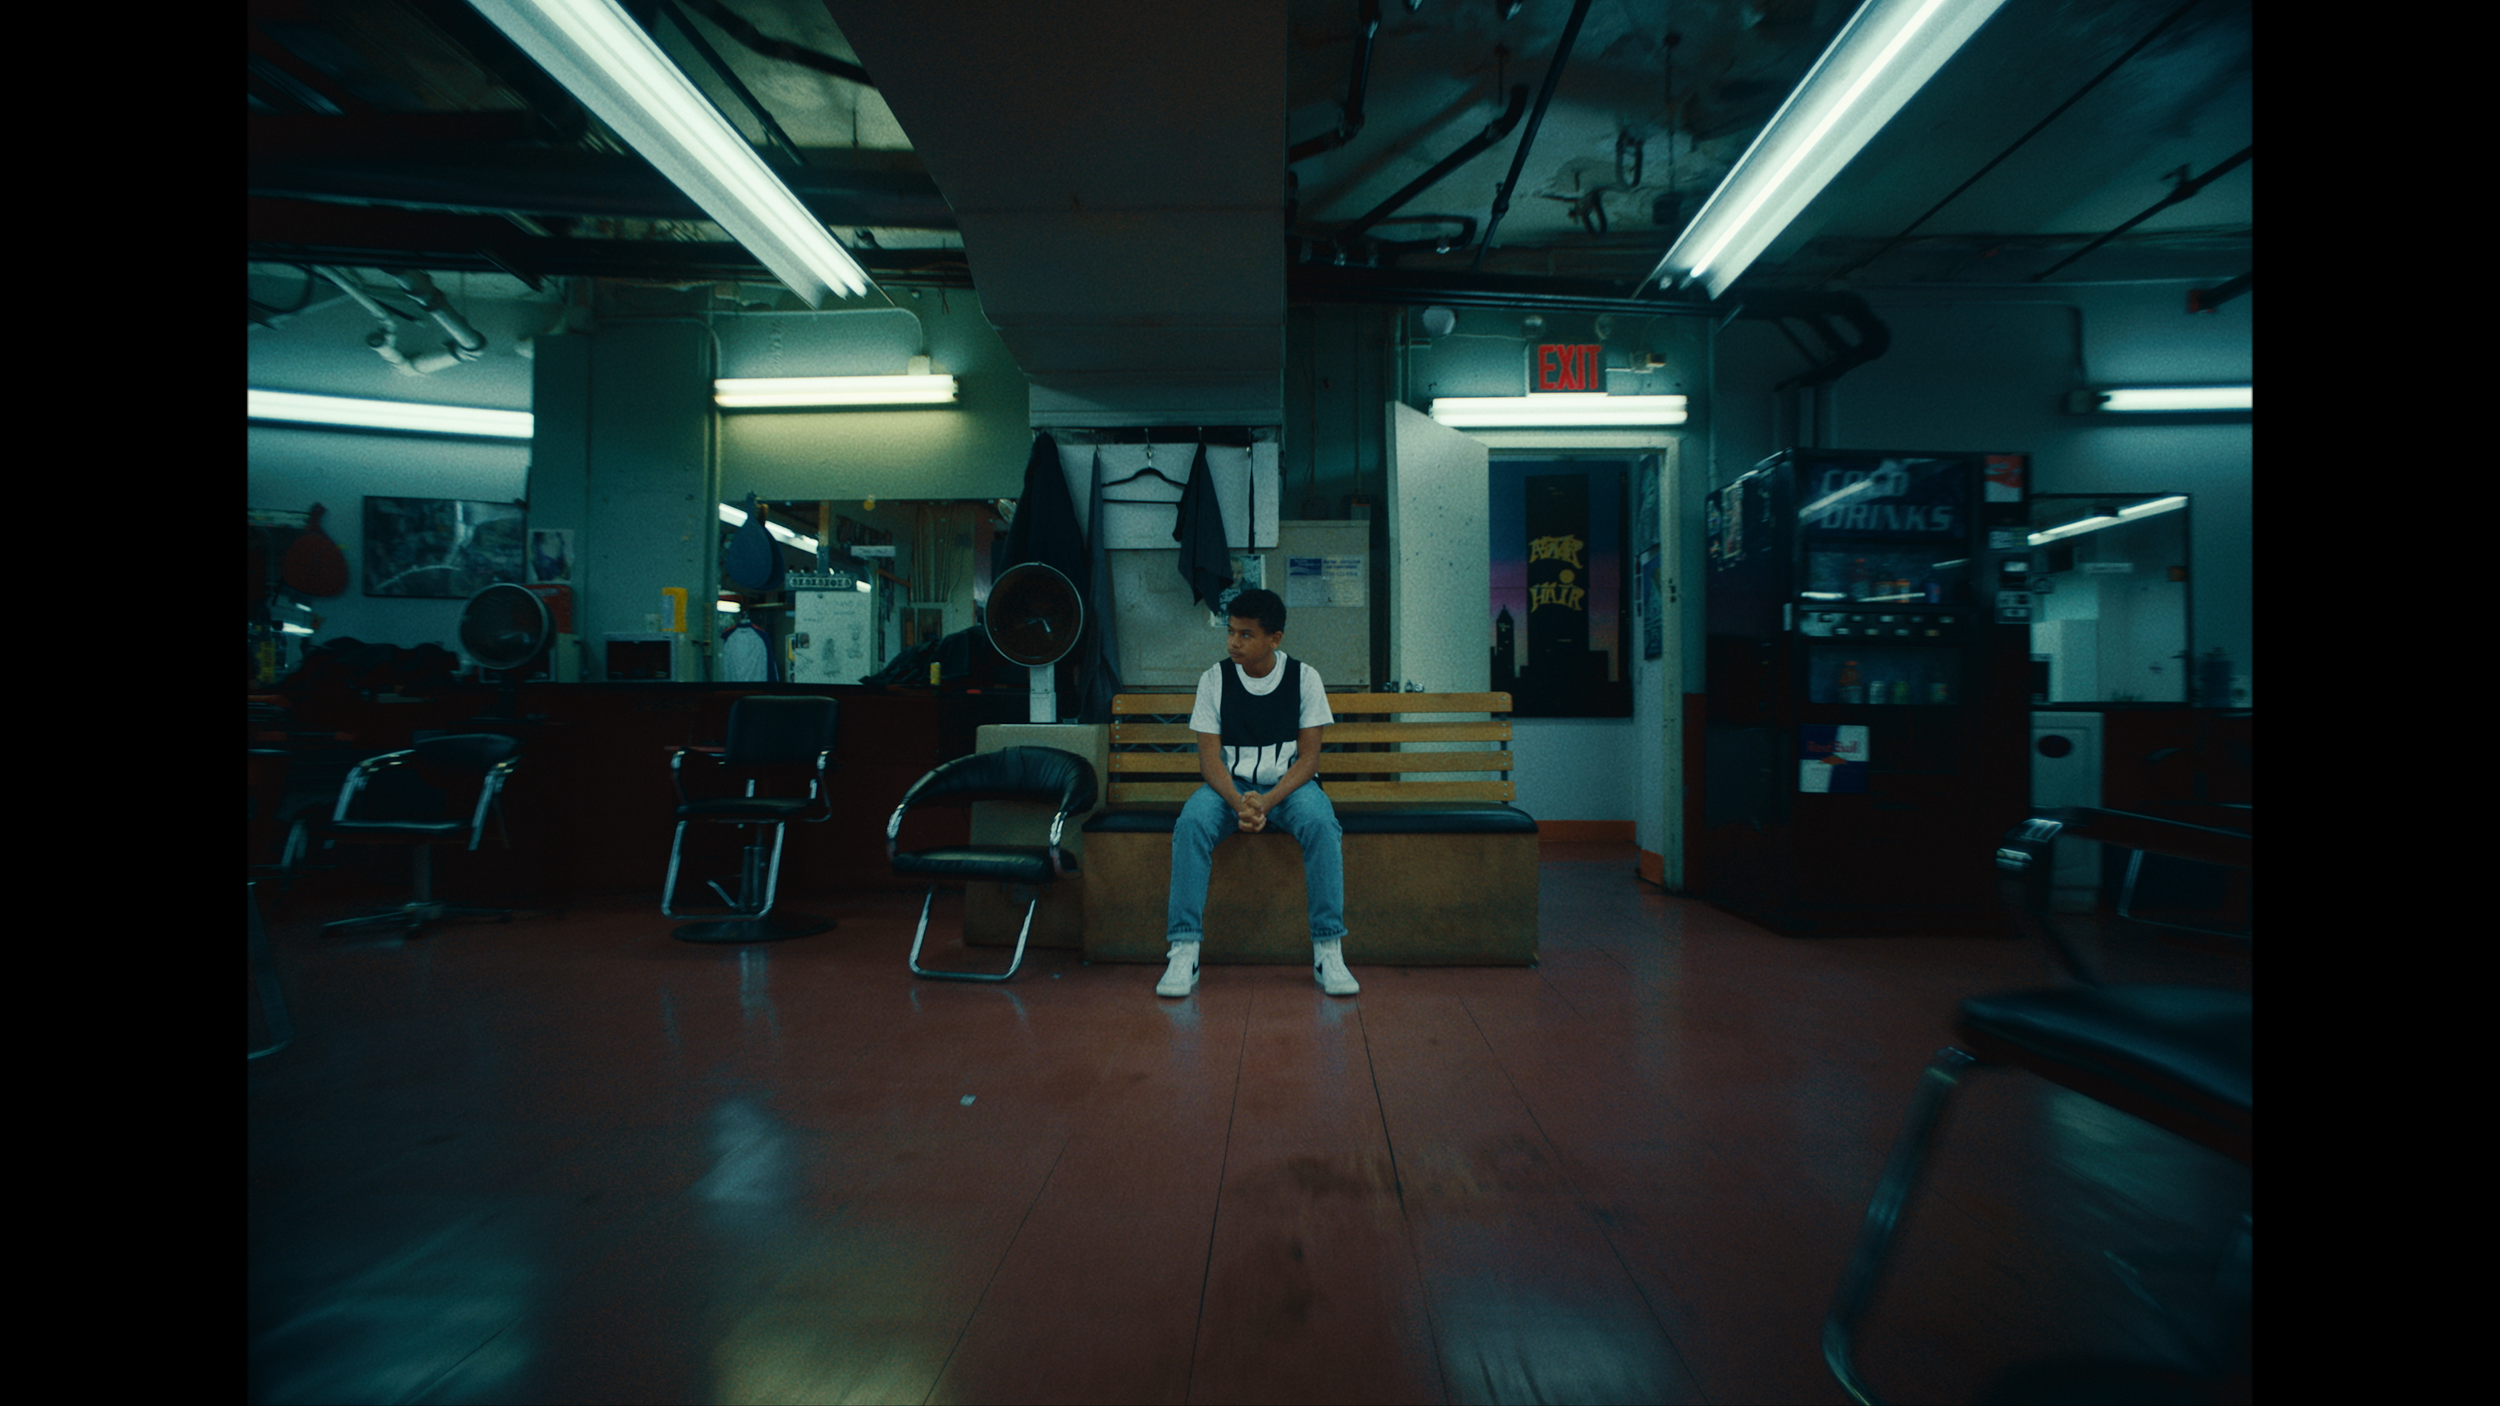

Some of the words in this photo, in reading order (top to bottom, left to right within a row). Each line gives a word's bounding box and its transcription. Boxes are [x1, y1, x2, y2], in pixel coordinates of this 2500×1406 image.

[1538, 344, 1602, 391] EXIT
[1820, 503, 1955, 532] DRINKS
[1529, 569, 1586, 613] HAIR
[1806, 740, 1832, 753] Red
[1833, 740, 1861, 753] Bull
